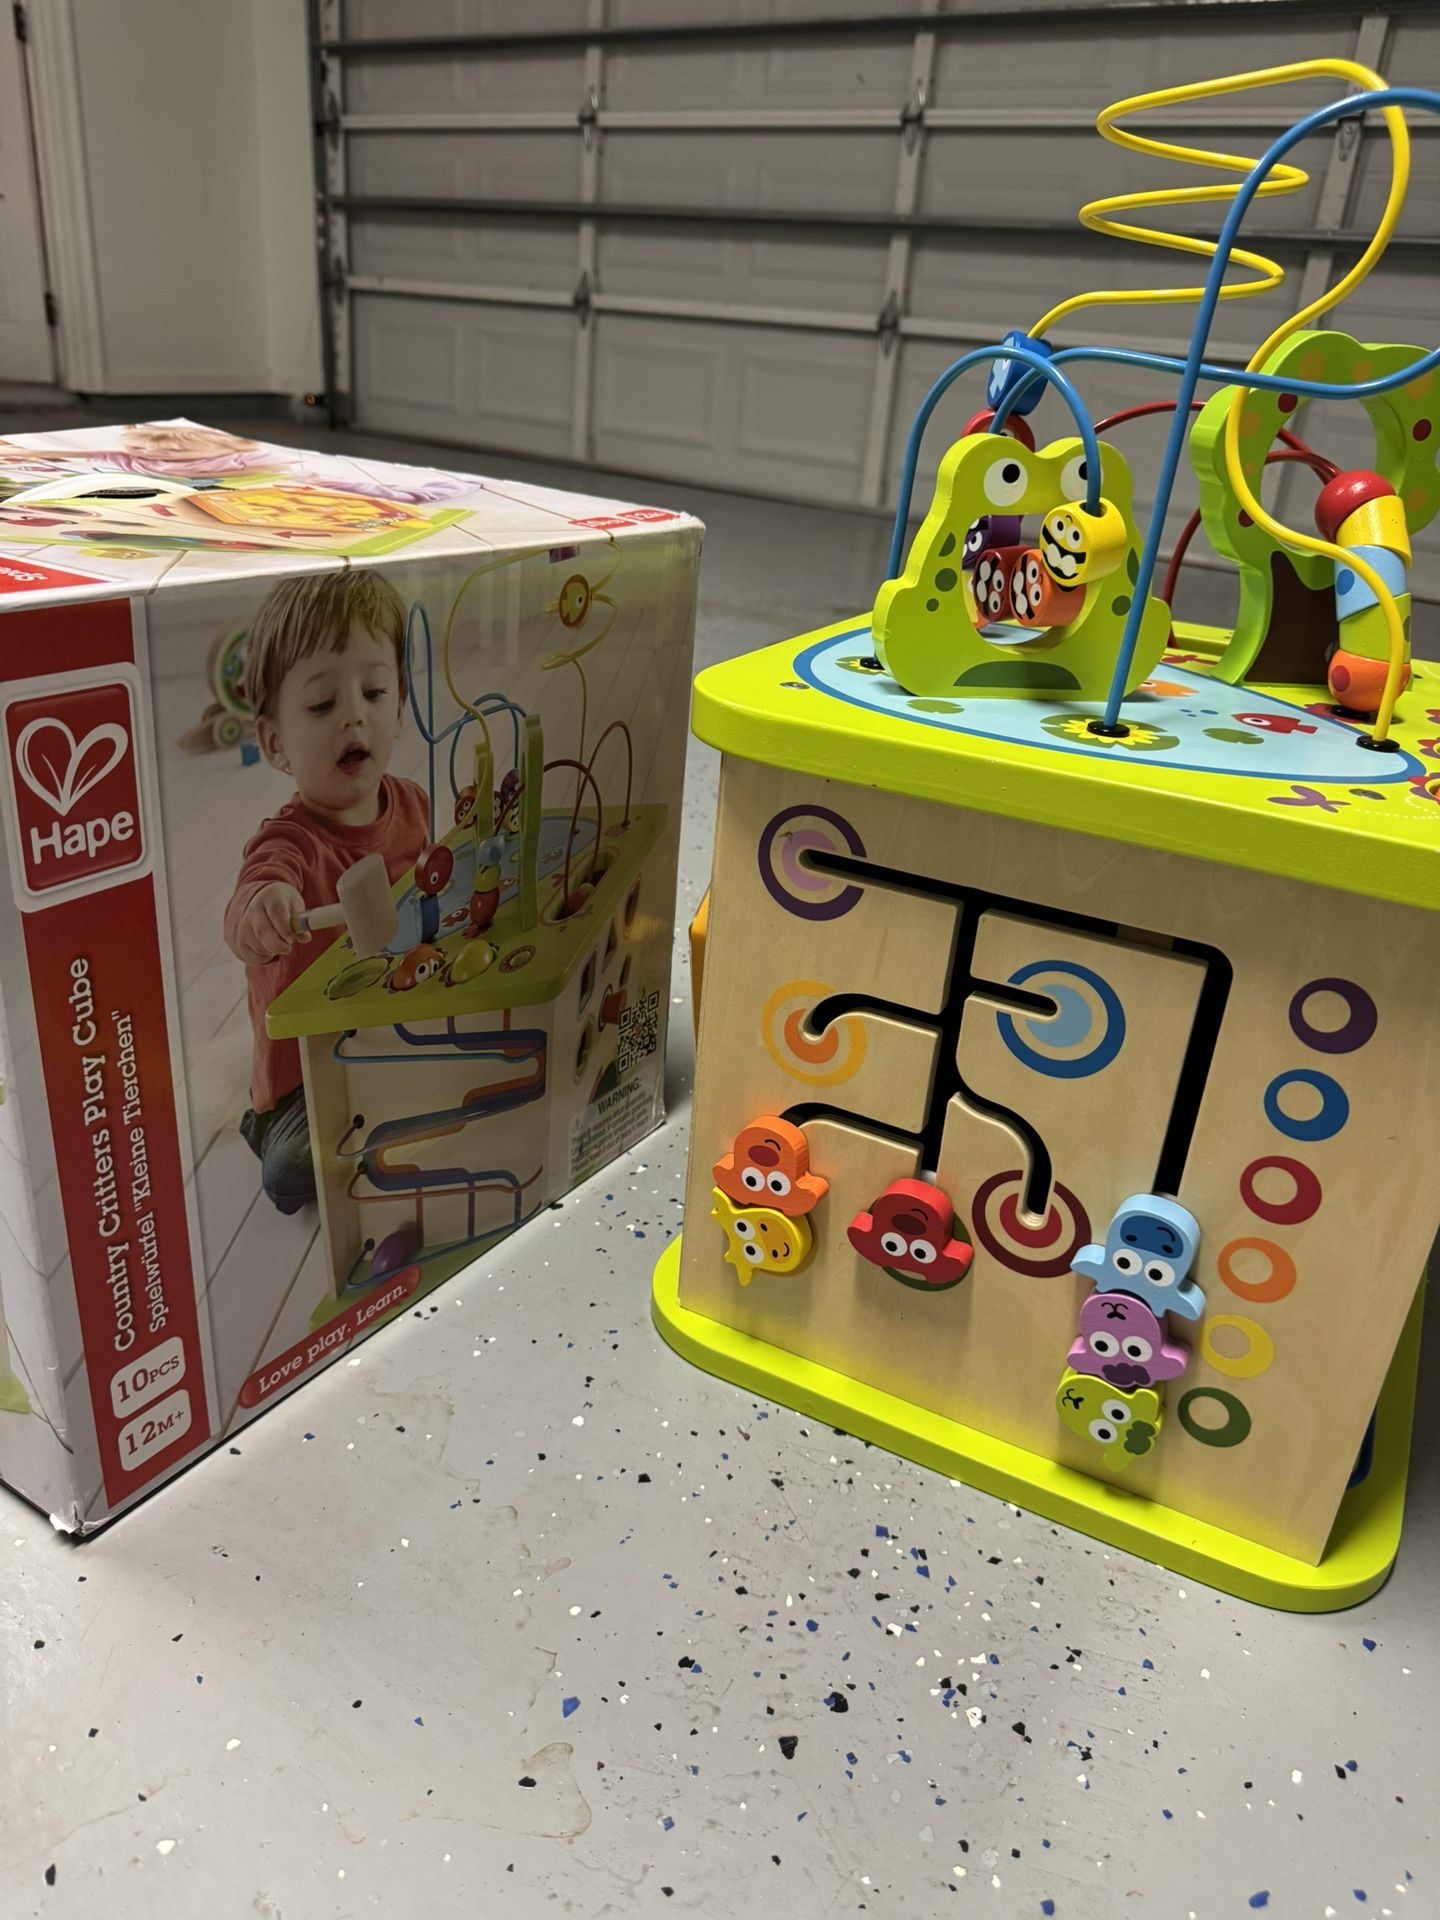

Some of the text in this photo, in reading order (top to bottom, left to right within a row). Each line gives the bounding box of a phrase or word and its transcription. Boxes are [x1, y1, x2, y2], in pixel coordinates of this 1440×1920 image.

[30, 811, 134, 865] Hape
[68, 958, 135, 1351] Country Critters Play Cube
[111, 1010, 169, 1333] Spielwürfel "Kleine Tierchen"
[117, 1355, 180, 1403] 10PCS
[258, 1285, 408, 1394] Love play. Learn.
[125, 1409, 185, 1455] 12M+
